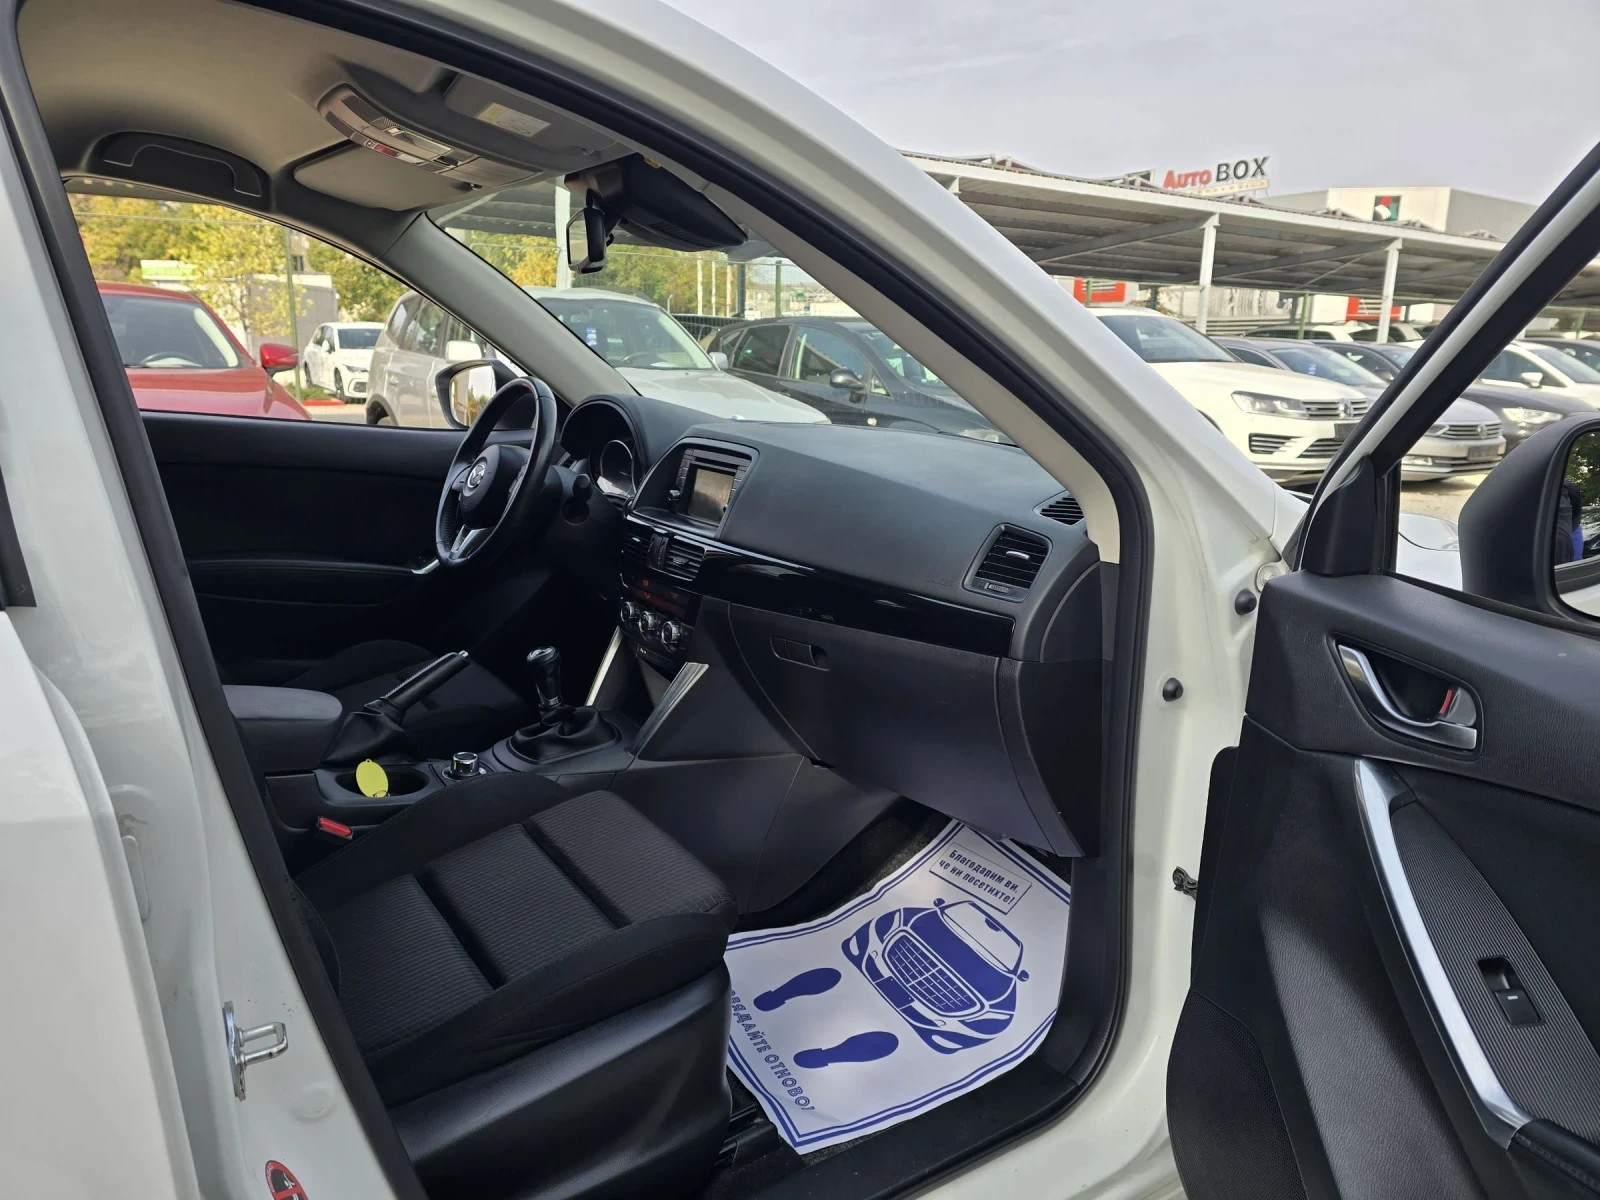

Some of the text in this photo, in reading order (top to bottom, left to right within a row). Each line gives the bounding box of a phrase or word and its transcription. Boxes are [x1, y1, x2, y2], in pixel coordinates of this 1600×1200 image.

[1216, 155, 1270, 182] BOX
[939, 860, 1016, 905] че ни посетихте!
[949, 849, 1019, 893] Благодарим ви,
[764, 1054, 816, 1111] ОТНОВО!
